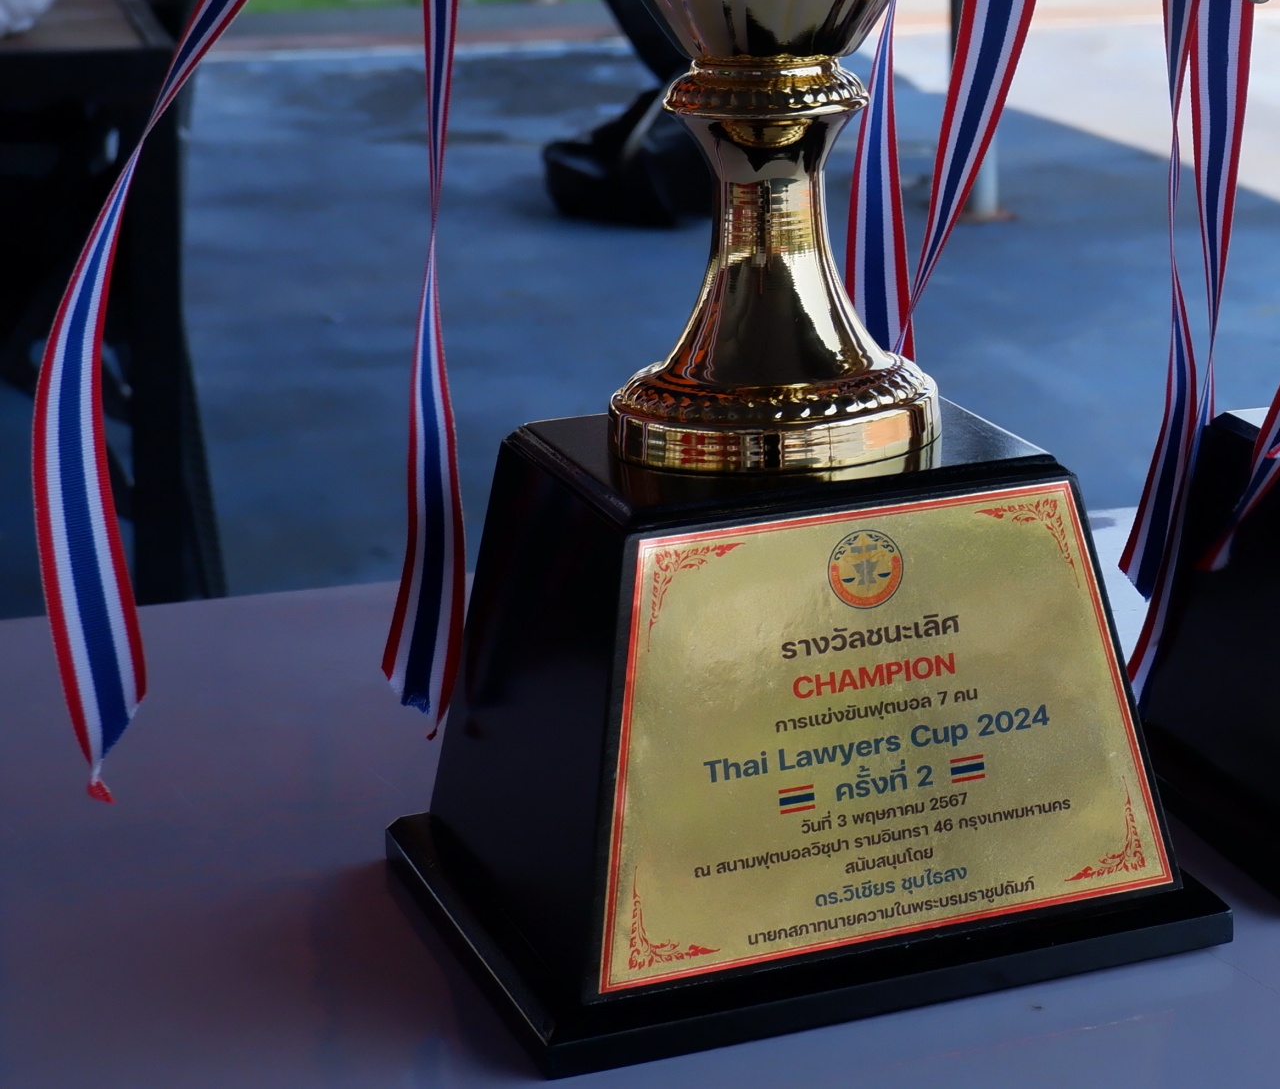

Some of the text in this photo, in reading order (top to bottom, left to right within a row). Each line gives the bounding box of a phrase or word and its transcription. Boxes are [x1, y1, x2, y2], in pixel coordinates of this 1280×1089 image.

[781, 613, 959, 659] รางวัลชนะเลิศ
[792, 652, 955, 699] CHAMPION
[775, 688, 978, 733] การแข่งขันฟุตบอล 7 คน
[703, 704, 1050, 783] Thai Lawyers Cup 2024
[835, 759, 933, 802] ครั้งที่ 2
[801, 791, 967, 834] วันที่ 3 พฤษภาคม 2567
[694, 798, 1071, 878] ณ สนามฟุตบอลวิชุปา รามอินทรา 46 กรุงเทพมหานคร
[845, 847, 933, 874] สนับสนุนโดย
[815, 866, 967, 907] ดร.วิเชียร ชุบไธสง
[747, 875, 1034, 945] นายกสภาทนายความในพระบรมราชูปถัมภ์
